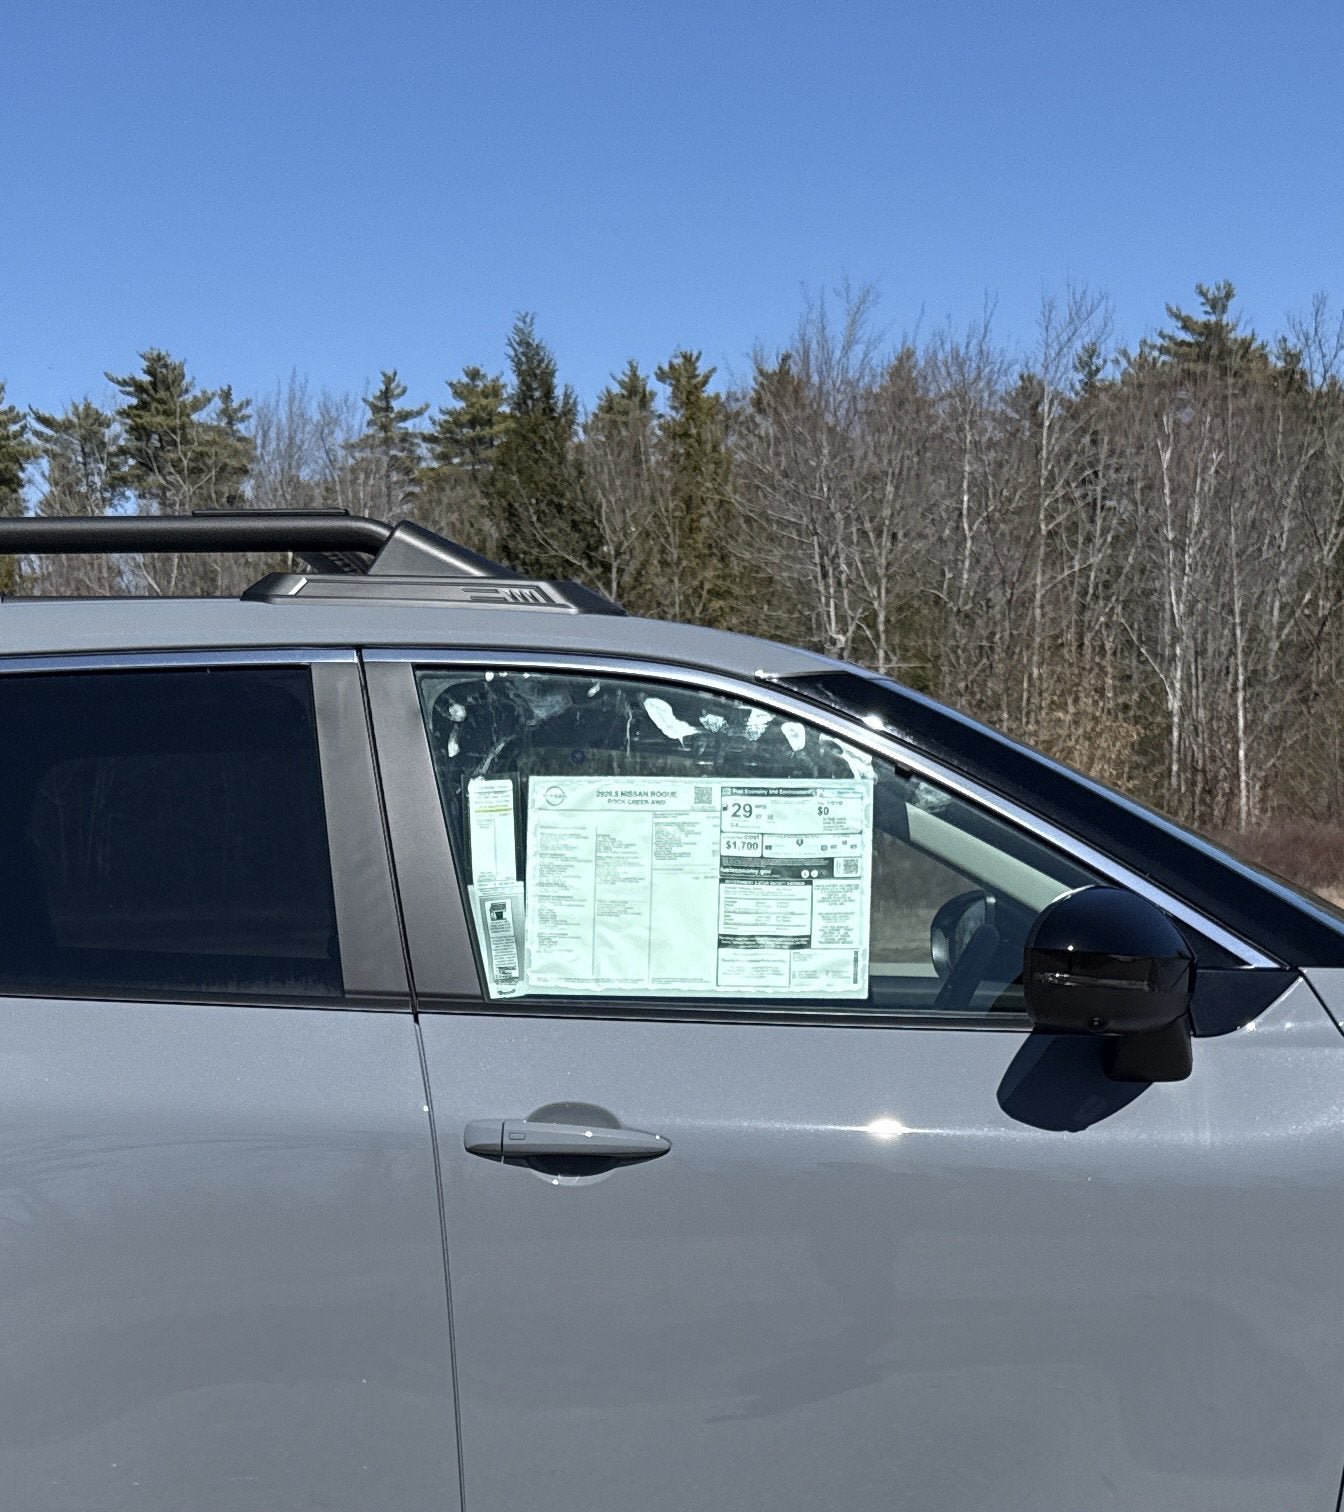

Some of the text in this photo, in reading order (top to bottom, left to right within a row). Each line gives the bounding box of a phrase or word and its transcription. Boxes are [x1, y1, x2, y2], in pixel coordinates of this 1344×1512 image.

[731, 802, 753, 819] 29
[817, 806, 830, 817] $0
[725, 840, 759, 852] $1,700
